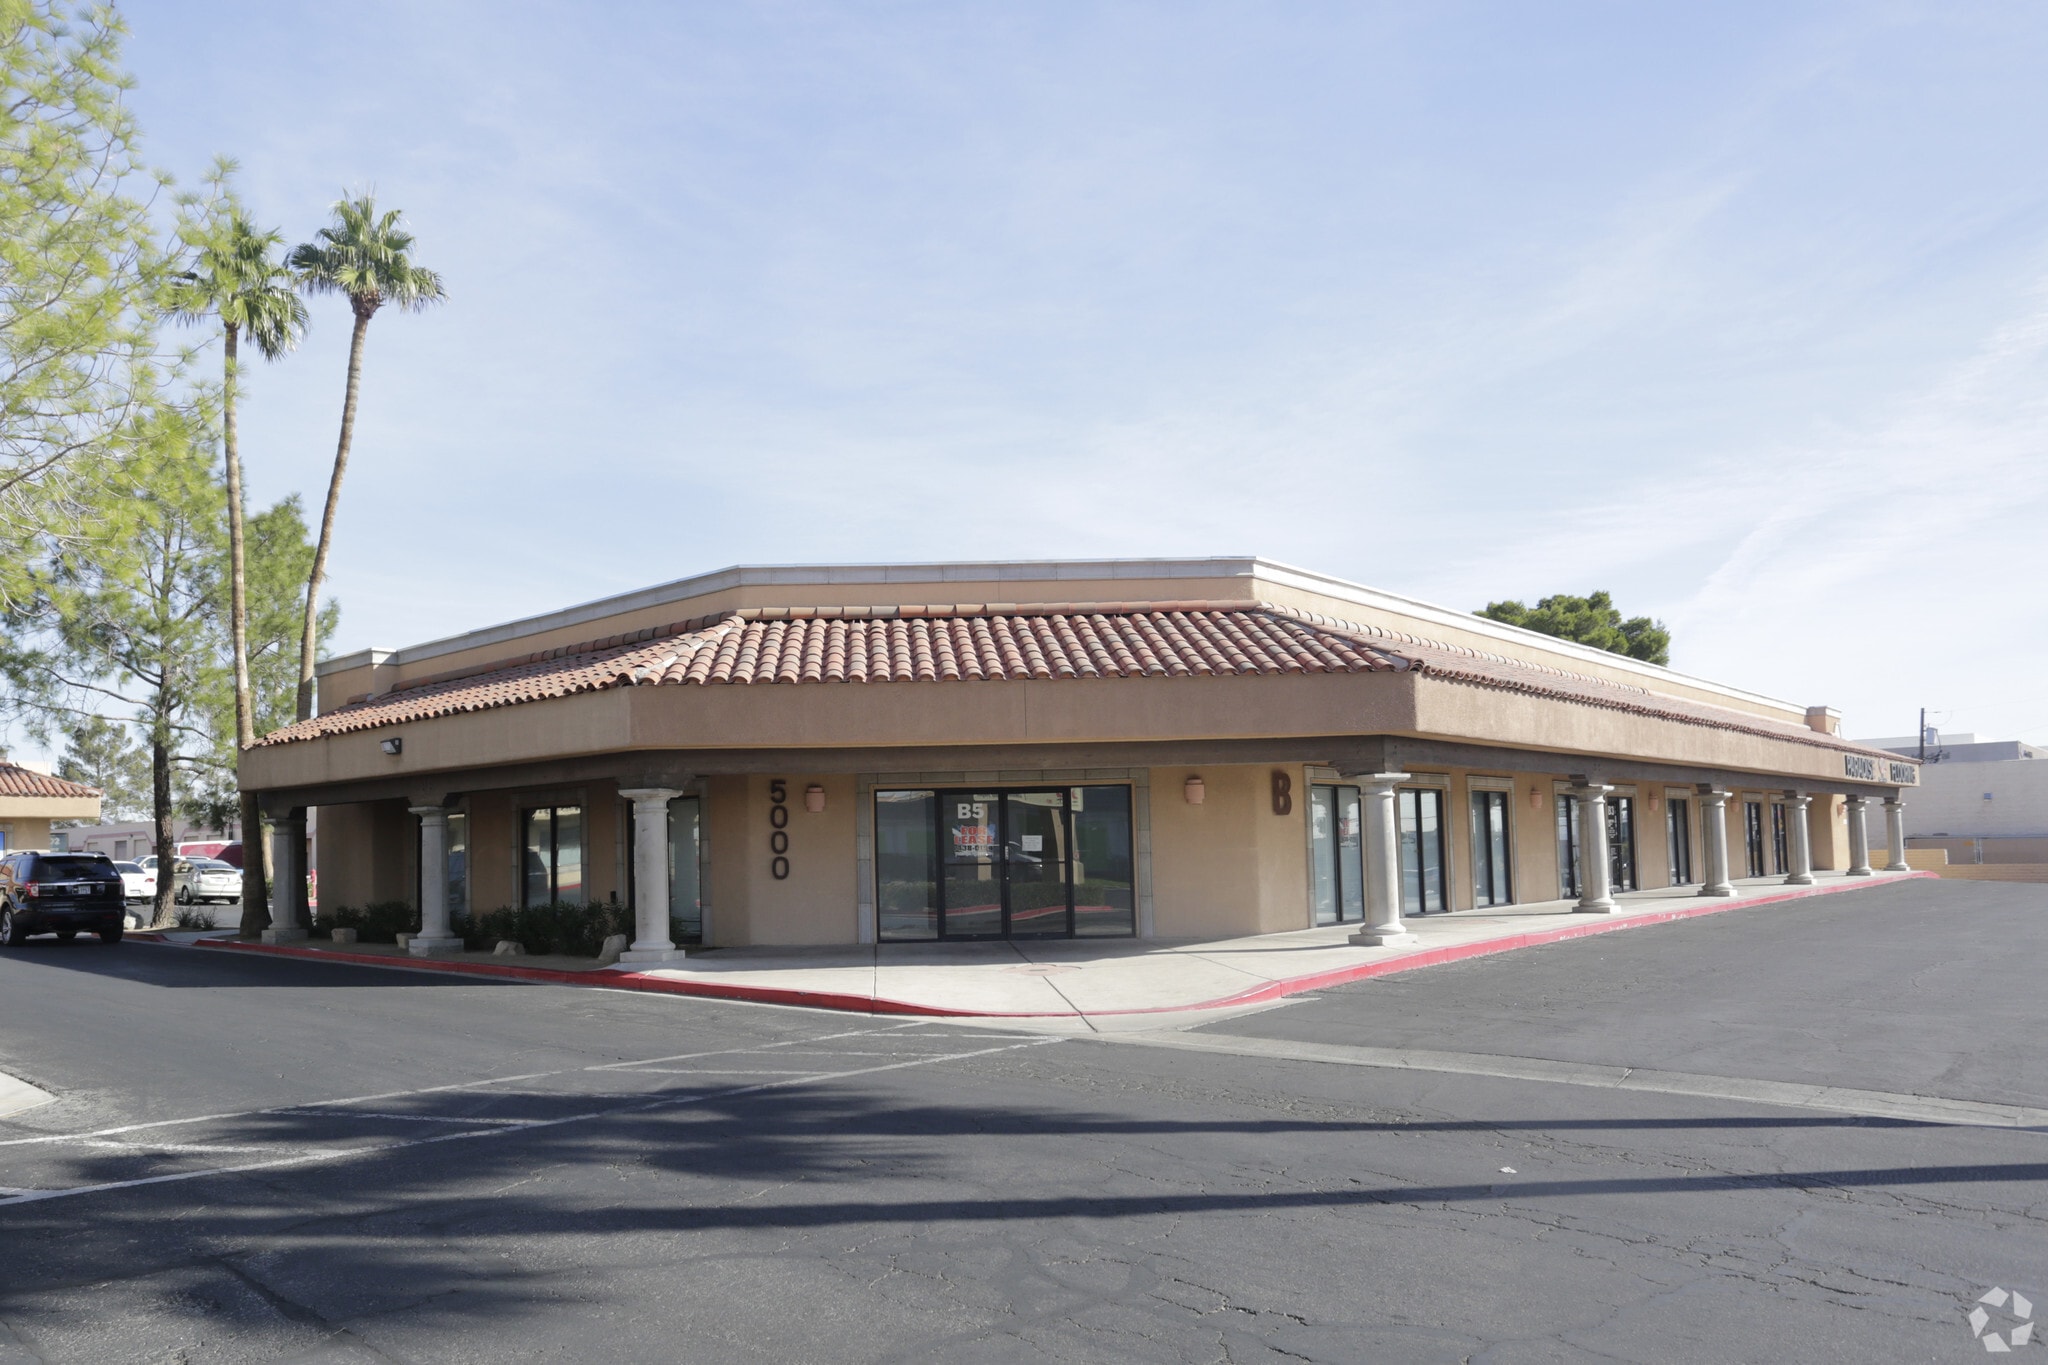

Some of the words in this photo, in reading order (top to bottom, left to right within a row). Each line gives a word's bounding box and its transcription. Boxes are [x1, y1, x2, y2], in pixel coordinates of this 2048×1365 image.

[1271, 769, 1292, 815] B
[957, 803, 984, 819] B5
[770, 779, 789, 880] 5000
[960, 826, 987, 835] FOR
[953, 835, 993, 845] LEASE
